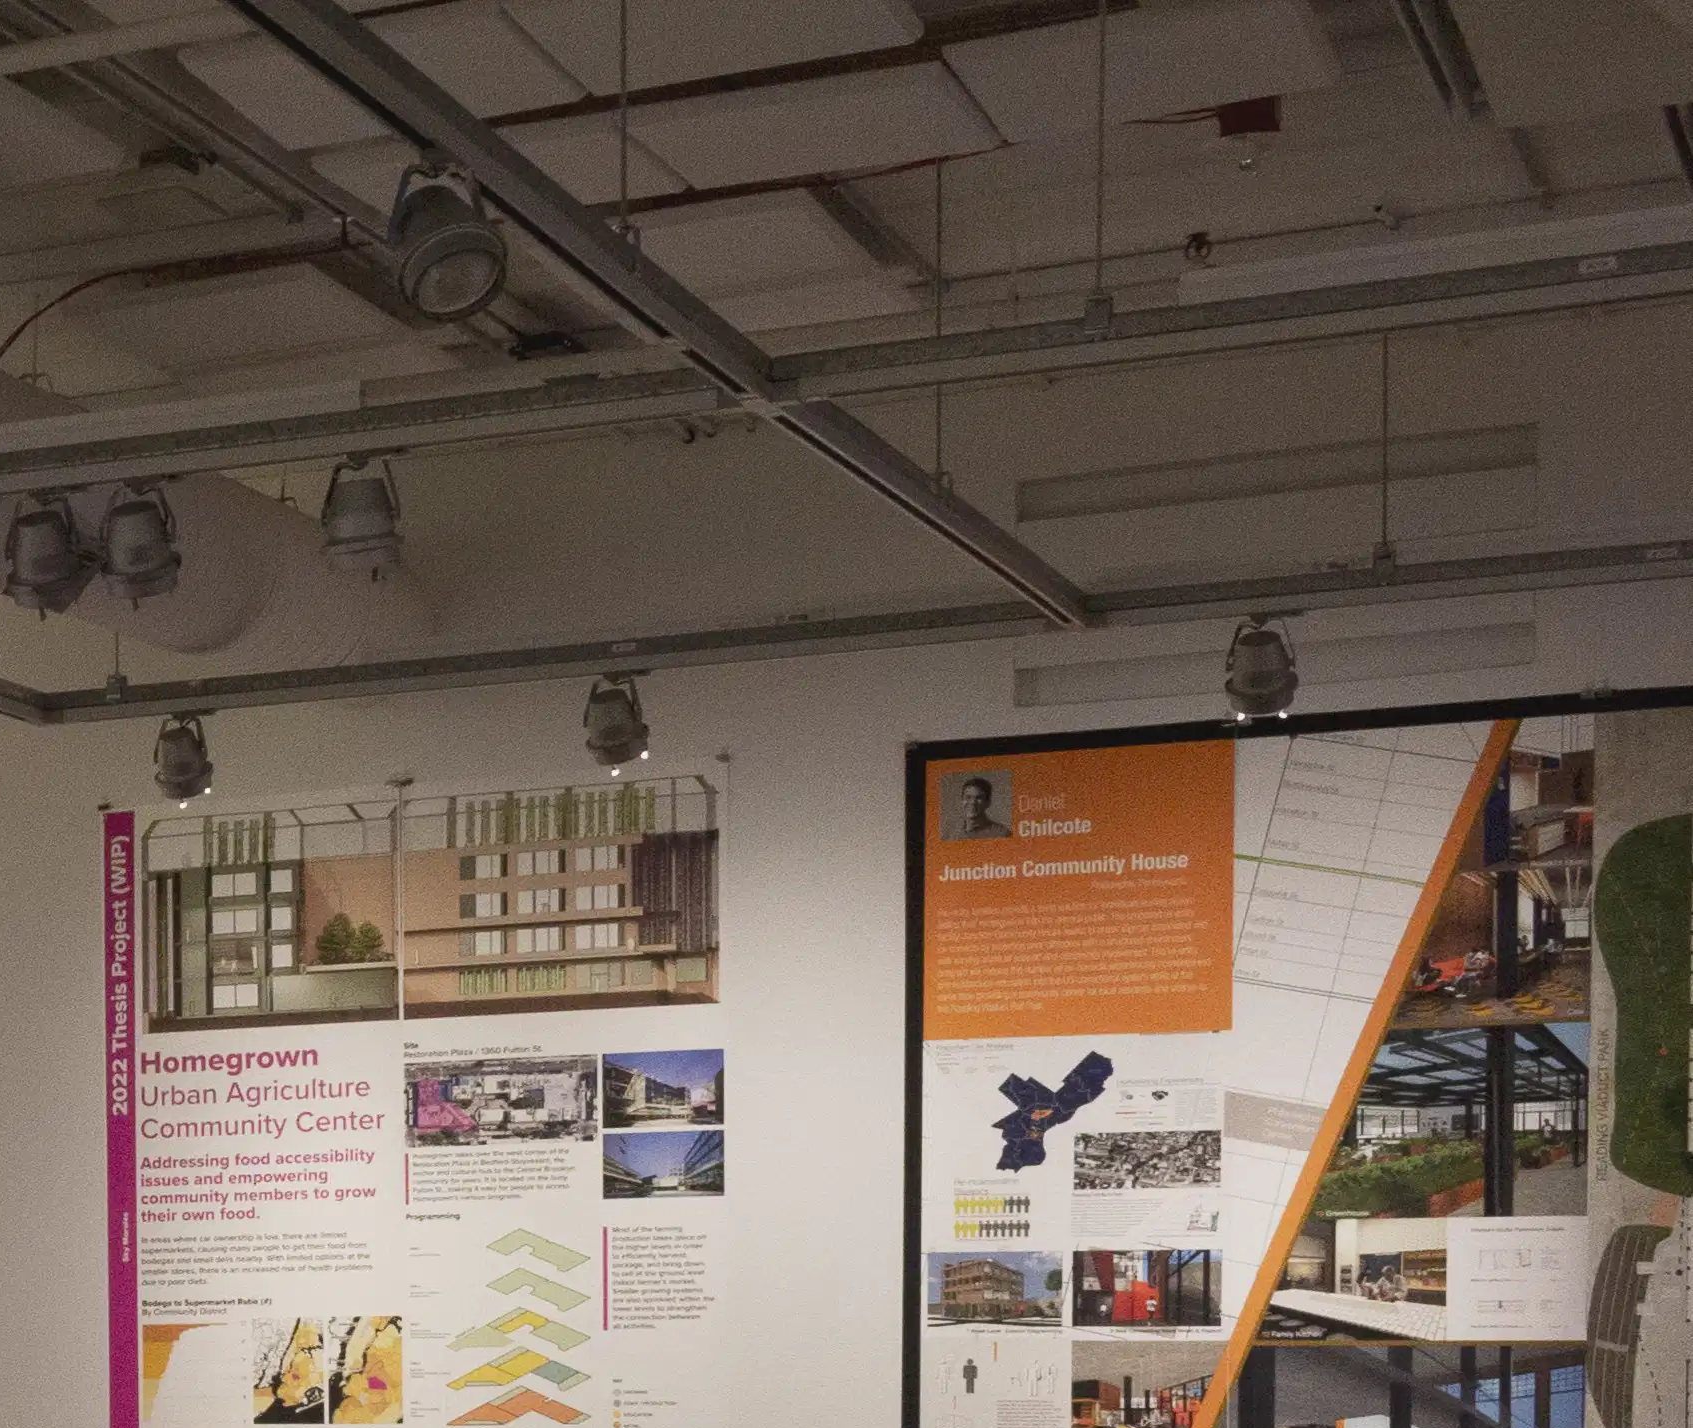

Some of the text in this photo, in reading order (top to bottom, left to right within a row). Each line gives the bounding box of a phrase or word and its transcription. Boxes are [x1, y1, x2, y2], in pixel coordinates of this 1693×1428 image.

[1018, 818, 1092, 838] Chilcote
[938, 853, 1189, 882] Junction Community House
[109, 835, 131, 1116] 2022 Thesis Project (WIP)
[1597, 1028, 1609, 1062] PARK
[140, 1048, 318, 1076] Homegrown
[140, 1077, 371, 1107] Urban Agriculture
[140, 1110, 385, 1139] Community Center
[139, 1147, 375, 1170] Addressing food accessibility
[140, 1167, 328, 1187] issues and empowering
[140, 1187, 376, 1206] community members to grow
[140, 1206, 260, 1222] their own food.
